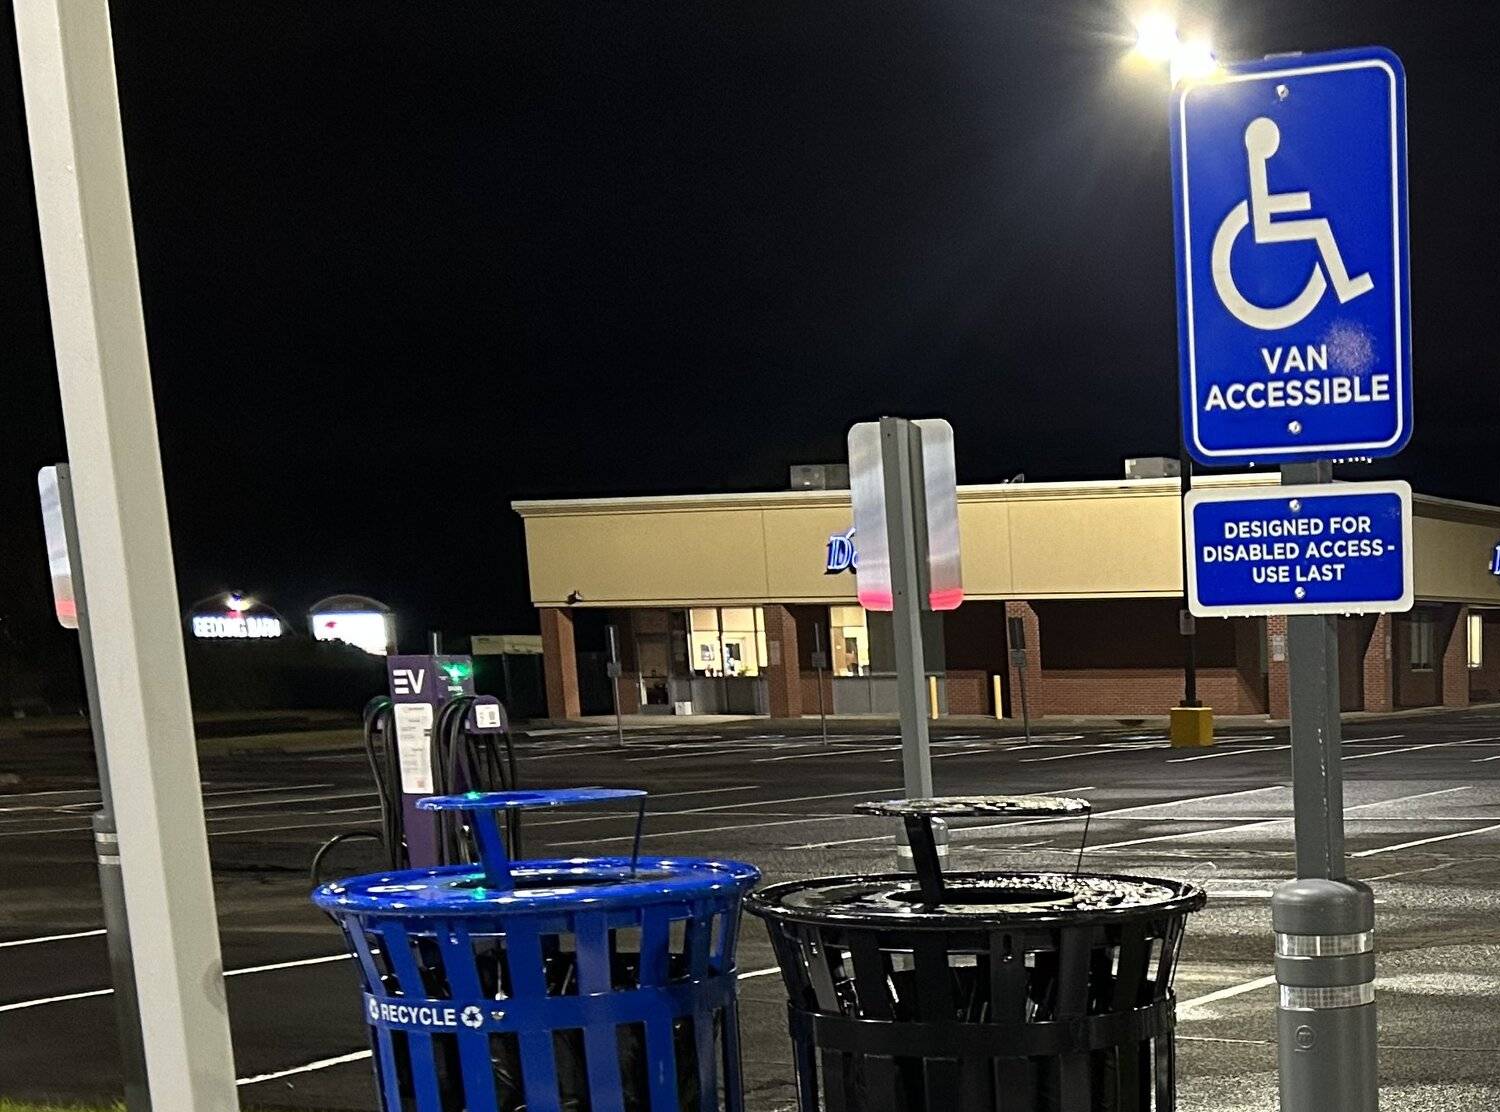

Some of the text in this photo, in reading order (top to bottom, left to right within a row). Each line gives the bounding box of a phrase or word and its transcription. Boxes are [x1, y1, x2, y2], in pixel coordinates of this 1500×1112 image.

[1261, 344, 1328, 374] VAN
[1204, 374, 1390, 411] ACCESSIBLE
[1224, 516, 1371, 539] DESIGNED FOR
[1203, 543, 1300, 563] DISABLED
[1305, 539, 1384, 559] ACCESS
[1252, 564, 1346, 583] USE LAST
[393, 669, 425, 694] EV
[381, 1003, 457, 1026] RECYCLE
